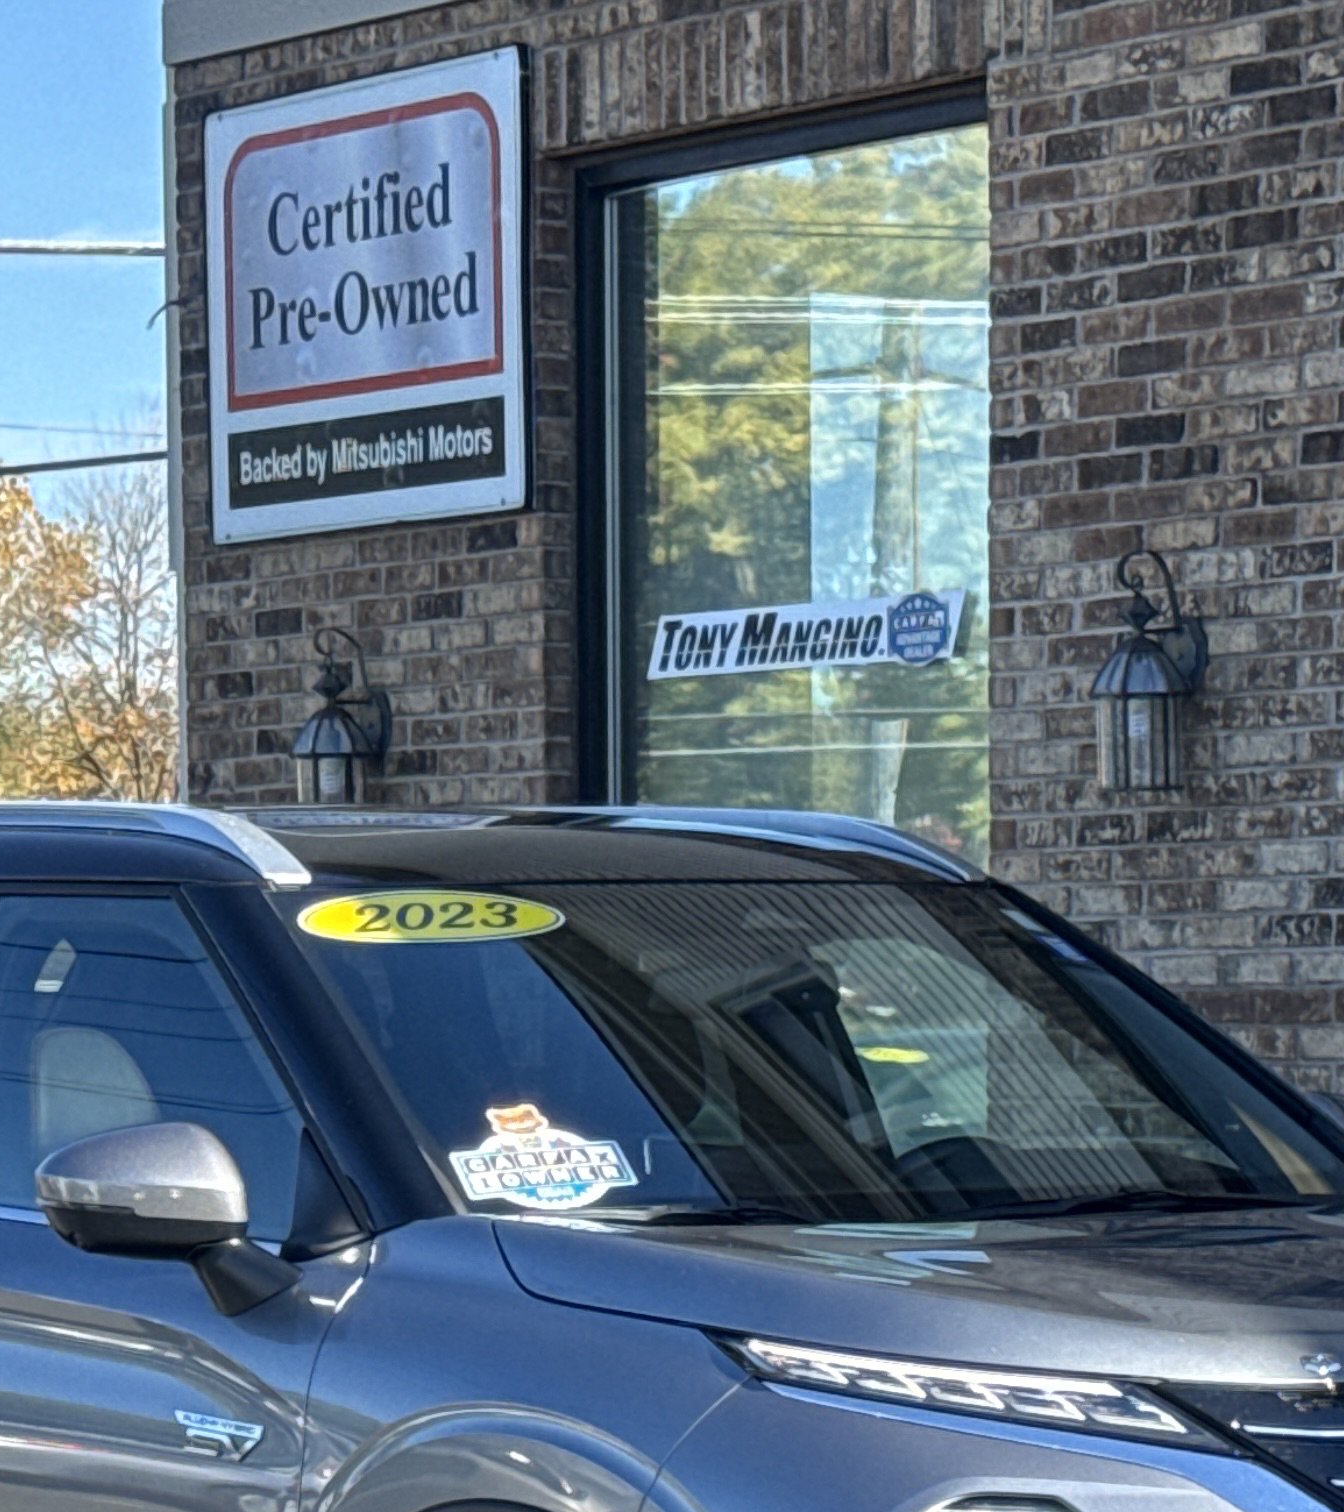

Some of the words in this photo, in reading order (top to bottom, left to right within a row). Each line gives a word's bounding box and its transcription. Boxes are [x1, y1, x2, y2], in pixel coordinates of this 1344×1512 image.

[267, 162, 452, 256] Certified
[248, 251, 479, 350] Pre-Owned
[239, 444, 302, 486] Backed
[306, 443, 327, 485] by
[332, 426, 424, 474] Mitsubishi
[428, 424, 493, 462] Motors
[658, 620, 739, 672] TONY
[354, 901, 518, 933] 2023
[464, 1147, 618, 1174] CARFAX
